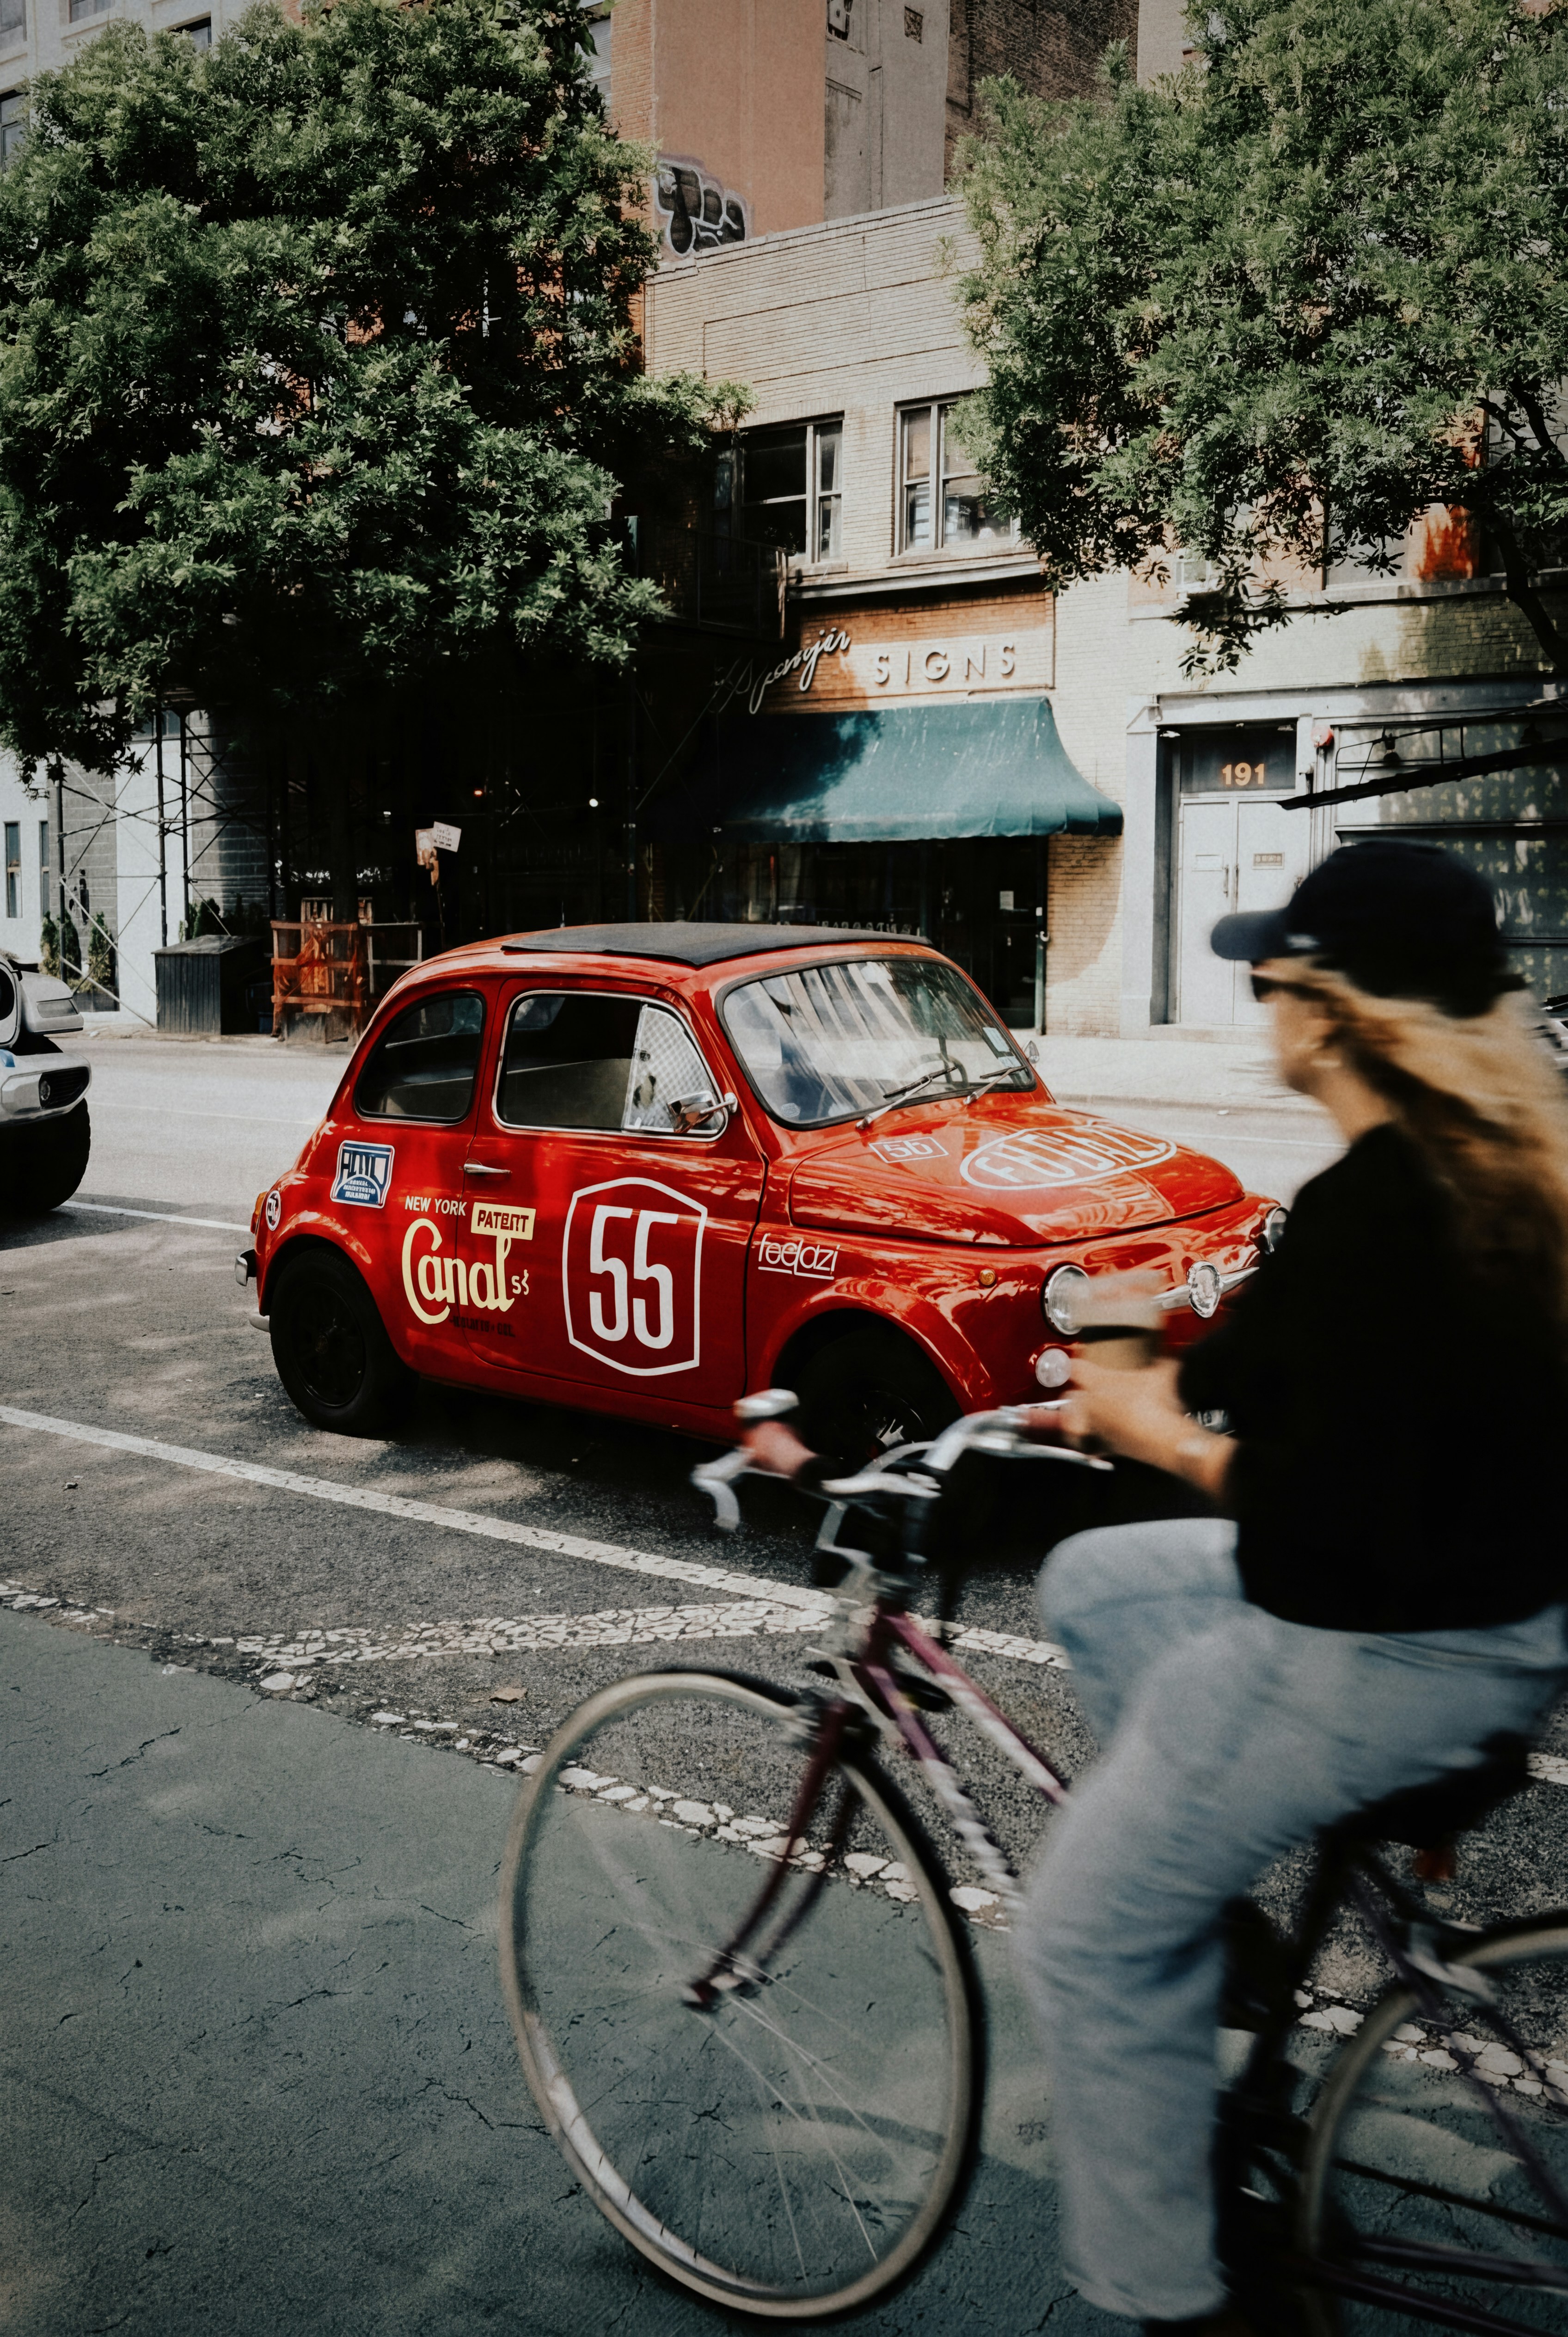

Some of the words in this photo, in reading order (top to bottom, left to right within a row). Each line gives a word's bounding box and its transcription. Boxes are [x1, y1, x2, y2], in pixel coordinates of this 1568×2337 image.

[873, 641, 1016, 685] SIGNS
[1222, 763, 1265, 786] 191
[405, 1195, 432, 1212] NEW
[435, 1199, 468, 1216] YORK
[402, 1218, 515, 1325] Canal
[589, 1205, 680, 1349] 55
